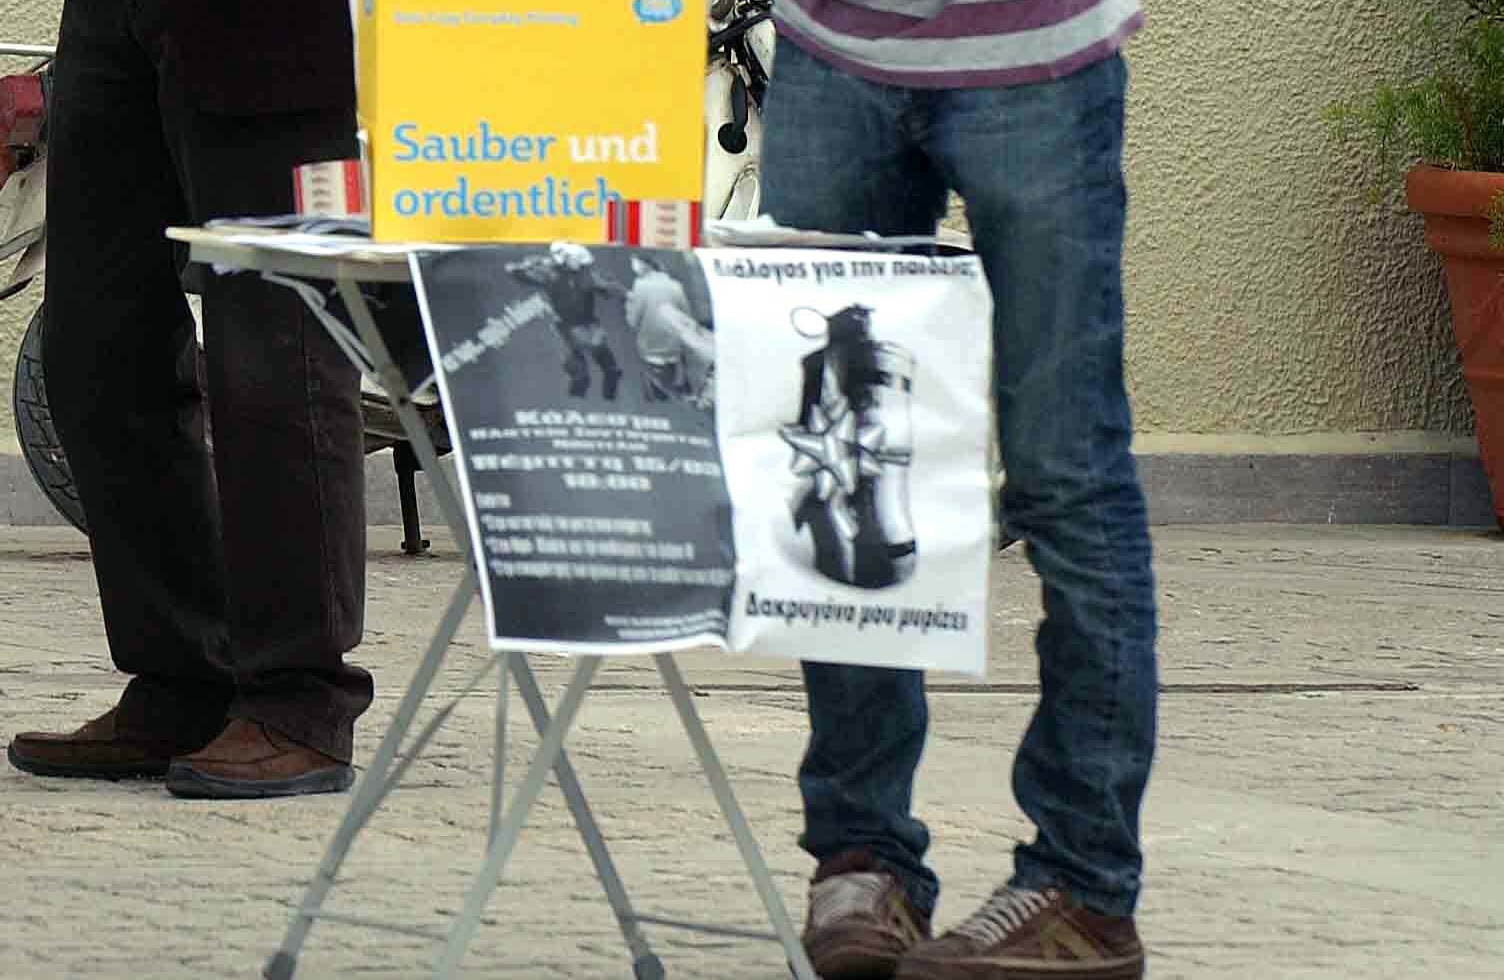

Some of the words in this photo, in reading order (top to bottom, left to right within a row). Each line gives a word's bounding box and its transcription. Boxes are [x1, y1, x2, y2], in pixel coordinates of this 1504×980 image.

[392, 121, 556, 162] Sauber
[567, 122, 657, 162] und
[392, 177, 623, 218] ordentlich
[812, 261, 846, 285] για
[851, 261, 885, 277] την
[858, 603, 896, 631] μου
